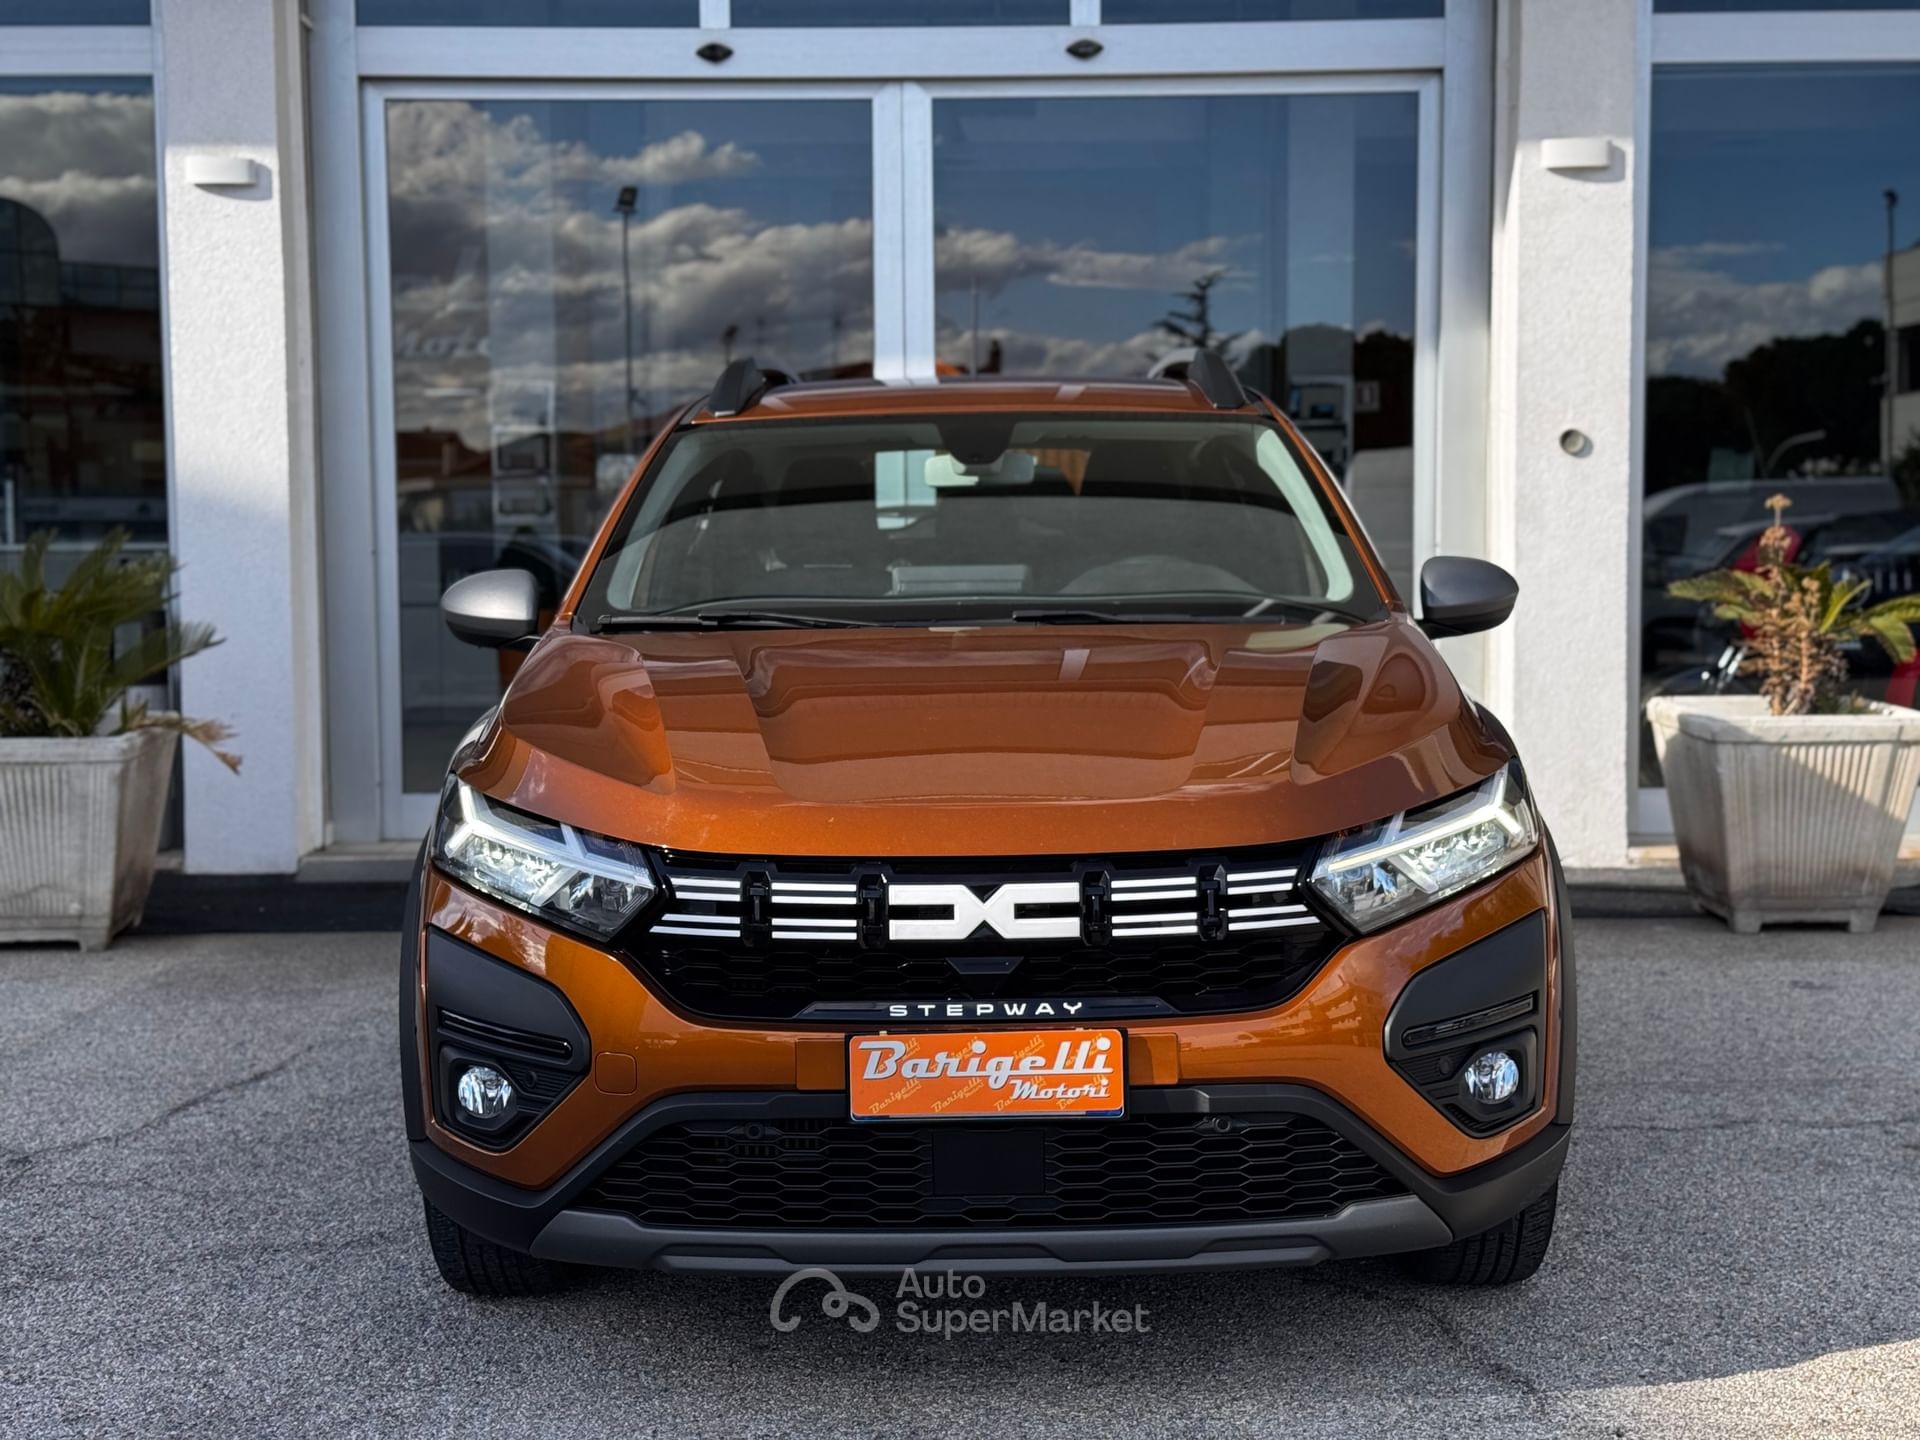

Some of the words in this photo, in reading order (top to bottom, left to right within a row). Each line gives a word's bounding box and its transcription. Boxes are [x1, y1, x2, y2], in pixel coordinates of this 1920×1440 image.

[889, 1001, 1083, 1017] STEPWAY
[858, 1036, 1114, 1091] Barigelli
[1009, 1078, 1111, 1100] Motori
